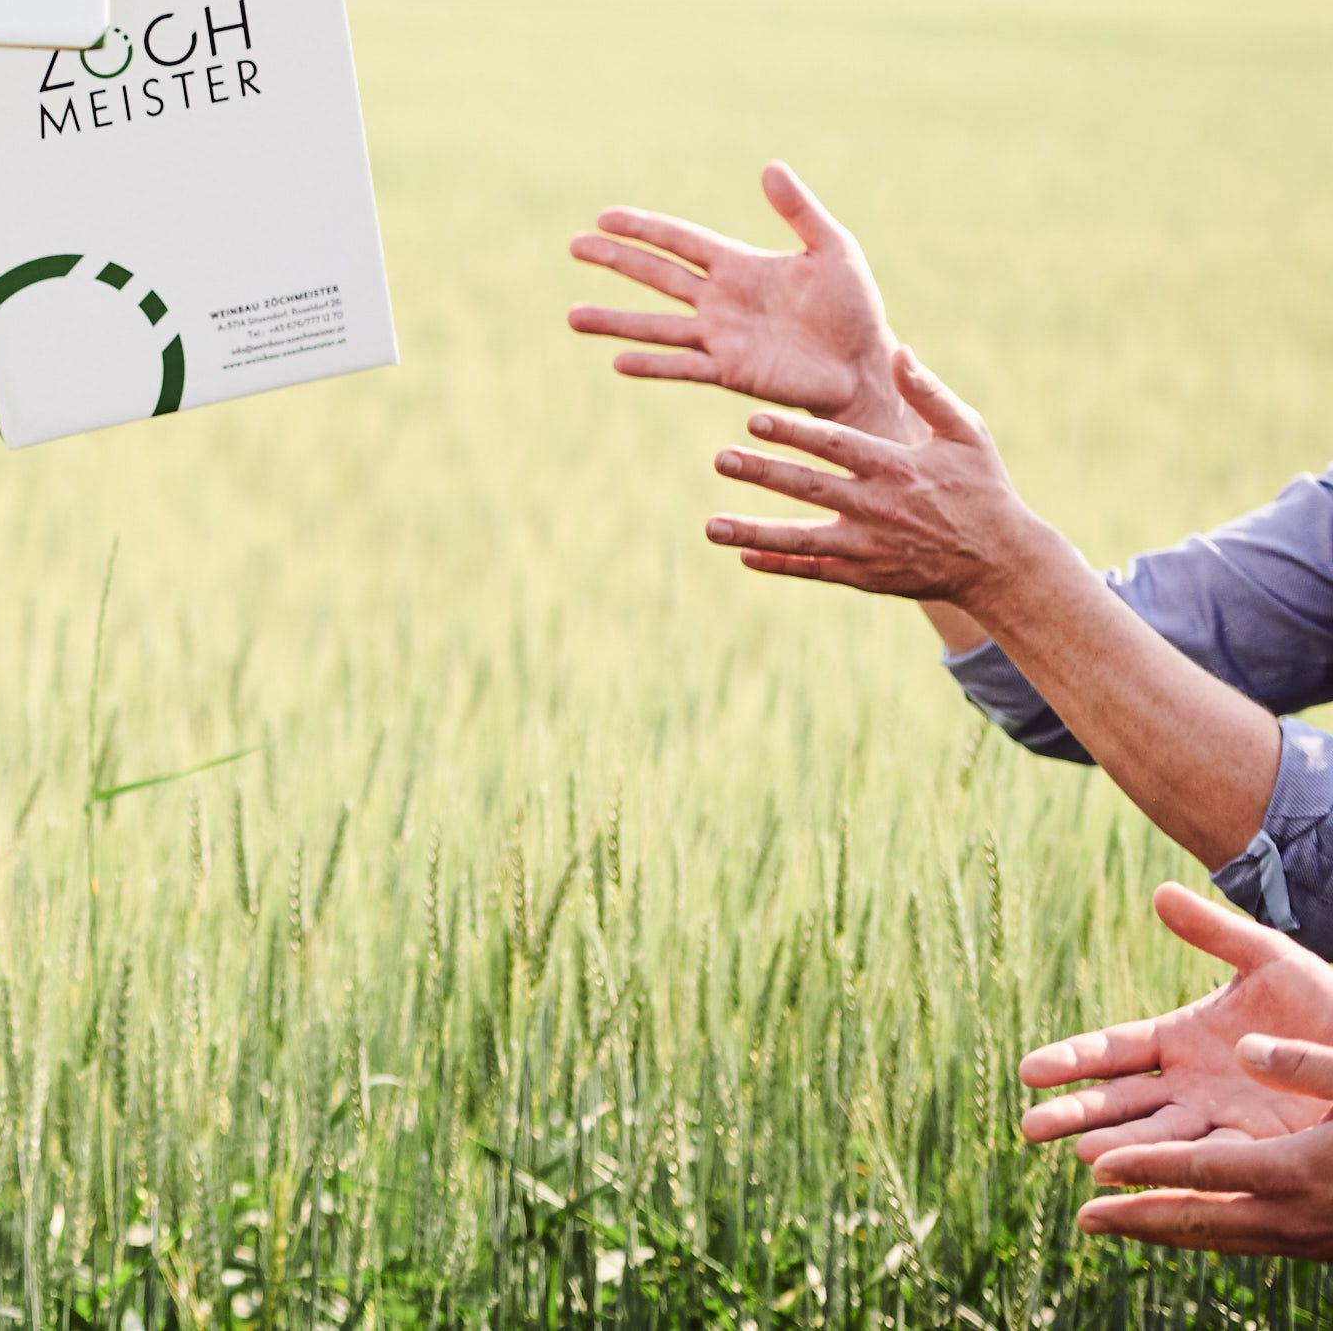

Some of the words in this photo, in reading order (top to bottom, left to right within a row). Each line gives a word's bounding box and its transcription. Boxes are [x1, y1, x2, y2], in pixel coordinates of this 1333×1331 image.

[40, 60, 261, 139] MEISTER
[209, 304, 260, 320] WEINBAU
[264, 285, 340, 308] ZÖCHMEISTER
